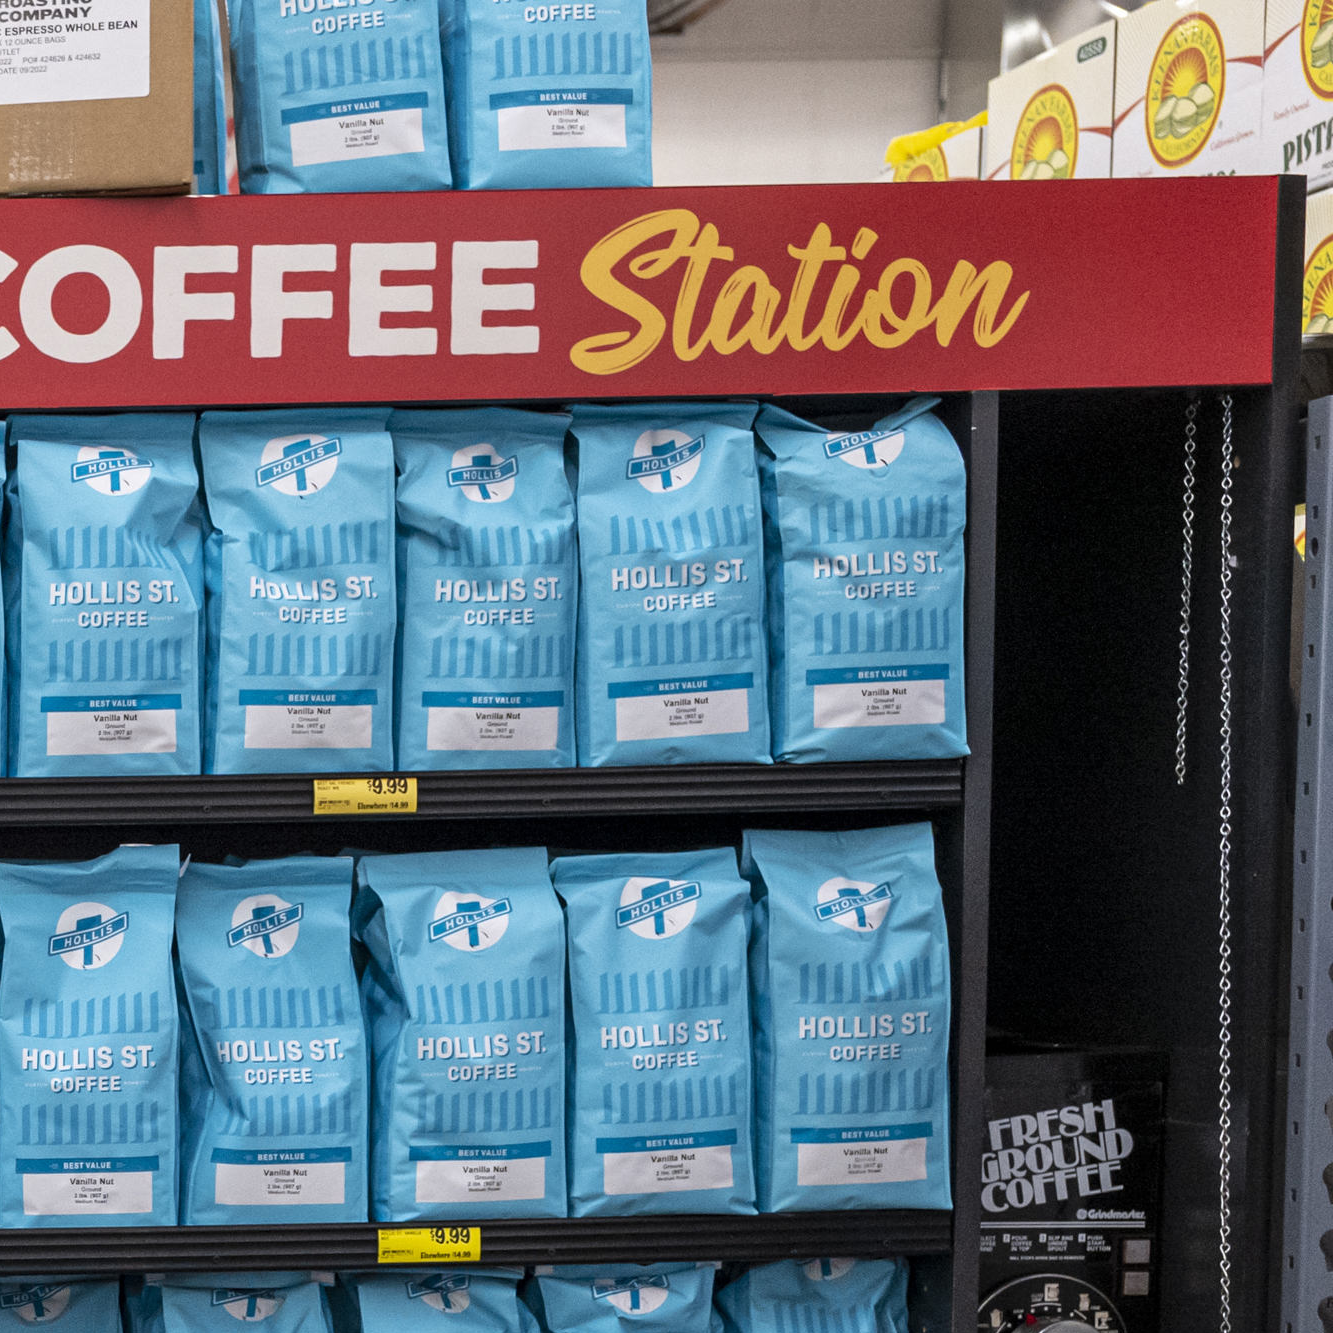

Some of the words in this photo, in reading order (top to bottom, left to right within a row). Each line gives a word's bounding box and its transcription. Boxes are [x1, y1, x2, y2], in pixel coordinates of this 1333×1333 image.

[523, 4, 596, 23] COFFEE
[540, 93, 564, 102] BEST
[567, 91, 588, 101] VALUE
[546, 109, 572, 117] Vanilla
[570, 208, 1030, 376] Station
[367, 778, 408, 794] $9.99
[988, 1099, 1116, 1150] FRESH
[981, 1128, 1134, 1183] GROUND
[981, 1160, 1124, 1213] COFFEE
[1088, 1209, 1145, 1219] Grindmaster
